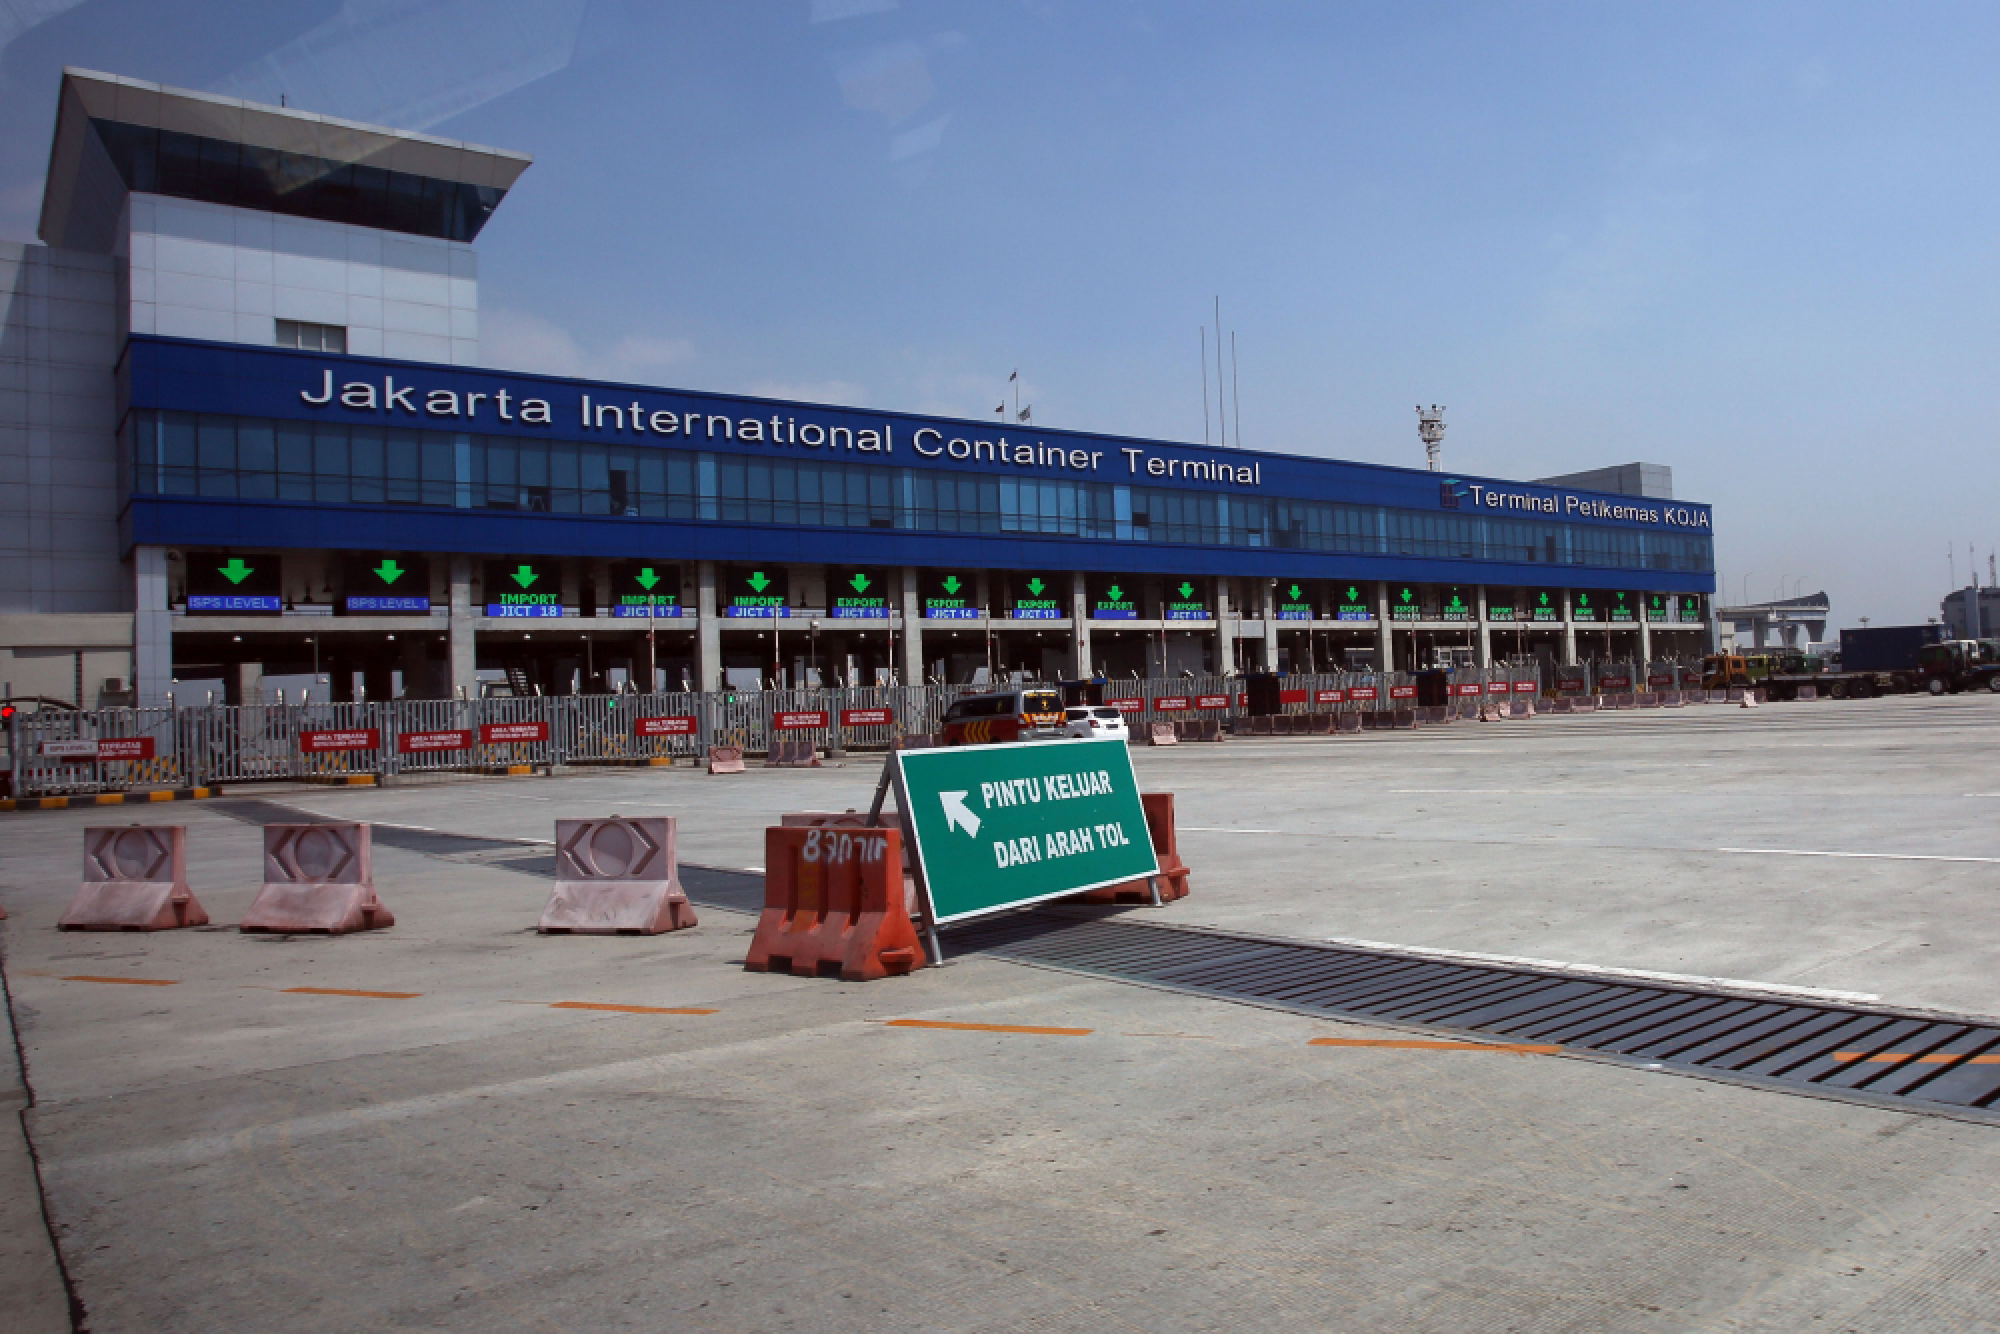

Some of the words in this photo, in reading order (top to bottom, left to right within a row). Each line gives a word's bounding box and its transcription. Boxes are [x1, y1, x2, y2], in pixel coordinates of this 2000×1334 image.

[301, 369, 552, 423] Jakarta
[581, 394, 892, 453] International
[913, 428, 1102, 469] Container
[1121, 448, 1260, 484] Terminal
[1469, 485, 1558, 513] Terminal
[1565, 495, 1658, 523] Petikemas
[1664, 507, 1709, 528] KOJA
[225, 597, 269, 608] LEVEL
[273, 597, 279, 608] 1
[379, 598, 419, 608] LEVEL
[499, 593, 558, 604] IMPORT
[621, 595, 676, 604] IMPORT
[734, 596, 785, 606] IMPORT
[837, 597, 885, 606] EXPORT
[926, 598, 966, 608] EXPORT
[499, 605, 533, 616] JICT
[540, 605, 558, 616] 18
[658, 606, 675, 616] 17
[734, 607, 764, 616] JICT
[981, 778, 1041, 809] PINTU
[1046, 769, 1113, 801] KELUAR
[993, 837, 1042, 869] DARI
[1046, 828, 1095, 861] ARAH
[1094, 822, 1131, 850] TOL
